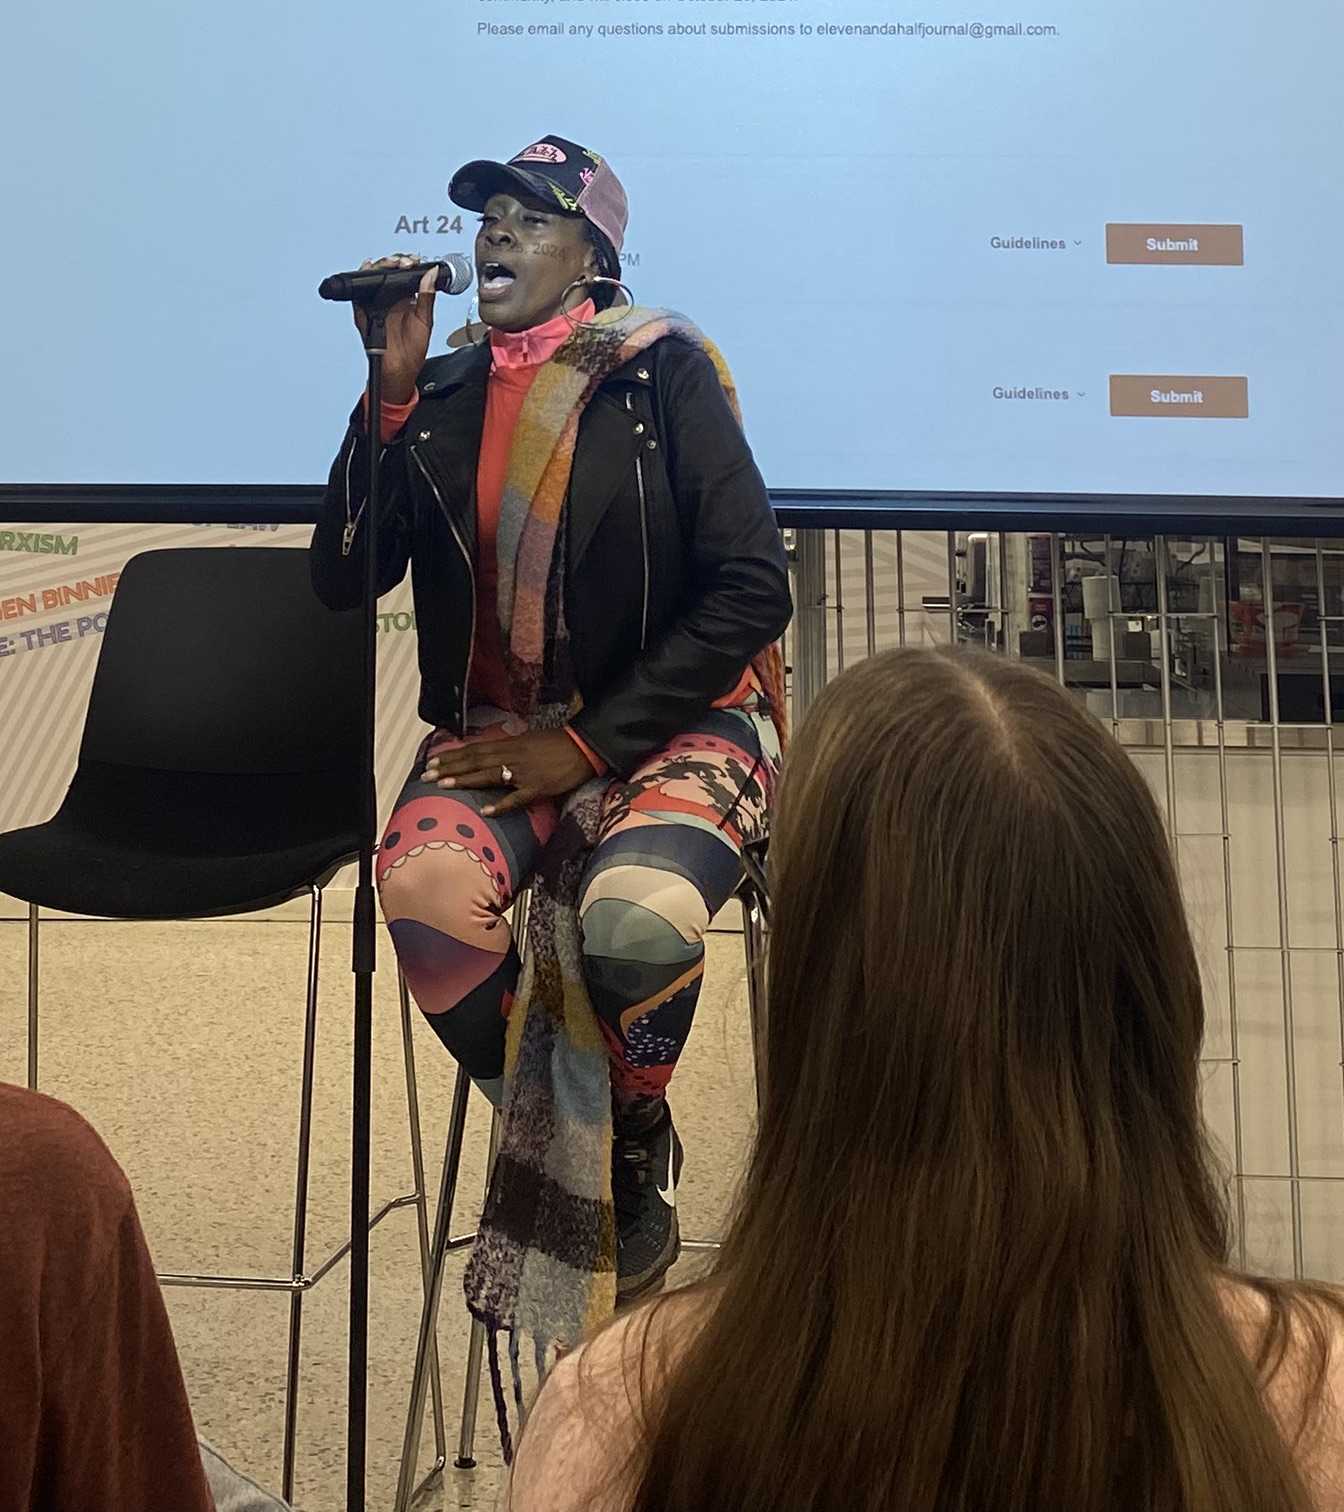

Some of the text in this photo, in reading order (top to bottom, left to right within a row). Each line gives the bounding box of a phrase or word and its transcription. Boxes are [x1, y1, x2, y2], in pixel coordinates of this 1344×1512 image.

[476, 21, 525, 36] Please
[526, 21, 565, 36] email
[567, 24, 594, 39] any
[596, 21, 664, 38] questions
[666, 22, 707, 36] about
[709, 21, 796, 36] submissions
[798, 22, 813, 36] to
[392, 215, 464, 235] Art 24
[988, 236, 1067, 250] Guidelines
[1145, 237, 1199, 252] Submit
[991, 386, 1070, 401] Guidelines
[1149, 389, 1204, 404] Submit
[20, 621, 73, 651] THE
